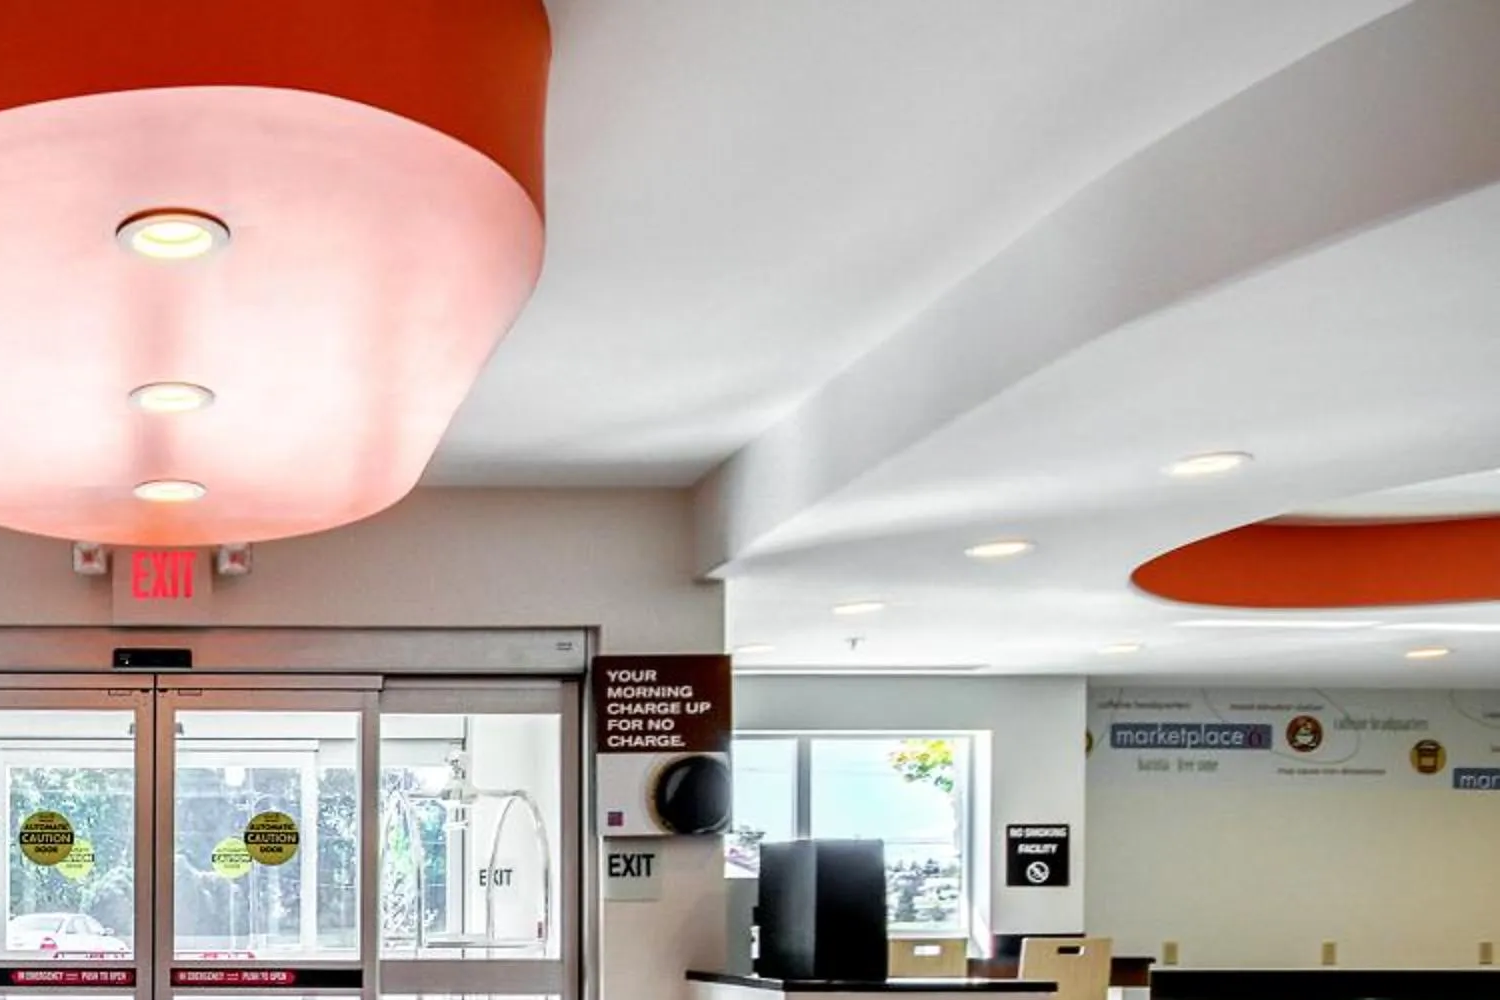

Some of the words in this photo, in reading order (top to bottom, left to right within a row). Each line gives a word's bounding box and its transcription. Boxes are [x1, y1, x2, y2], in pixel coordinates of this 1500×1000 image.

[131, 551, 196, 599] EXIT
[606, 669, 657, 682] YOUR
[607, 685, 694, 699] MORNING
[607, 702, 681, 716] CHARGE
[685, 701, 712, 714] UP
[607, 718, 644, 731] FOR
[647, 718, 675, 731] NO
[607, 734, 686, 748] CHARGE.
[1115, 722, 1244, 748] marketplace
[21, 833, 71, 843] CAUTION
[247, 833, 297, 843] CAUTION
[607, 853, 655, 878] EXIT
